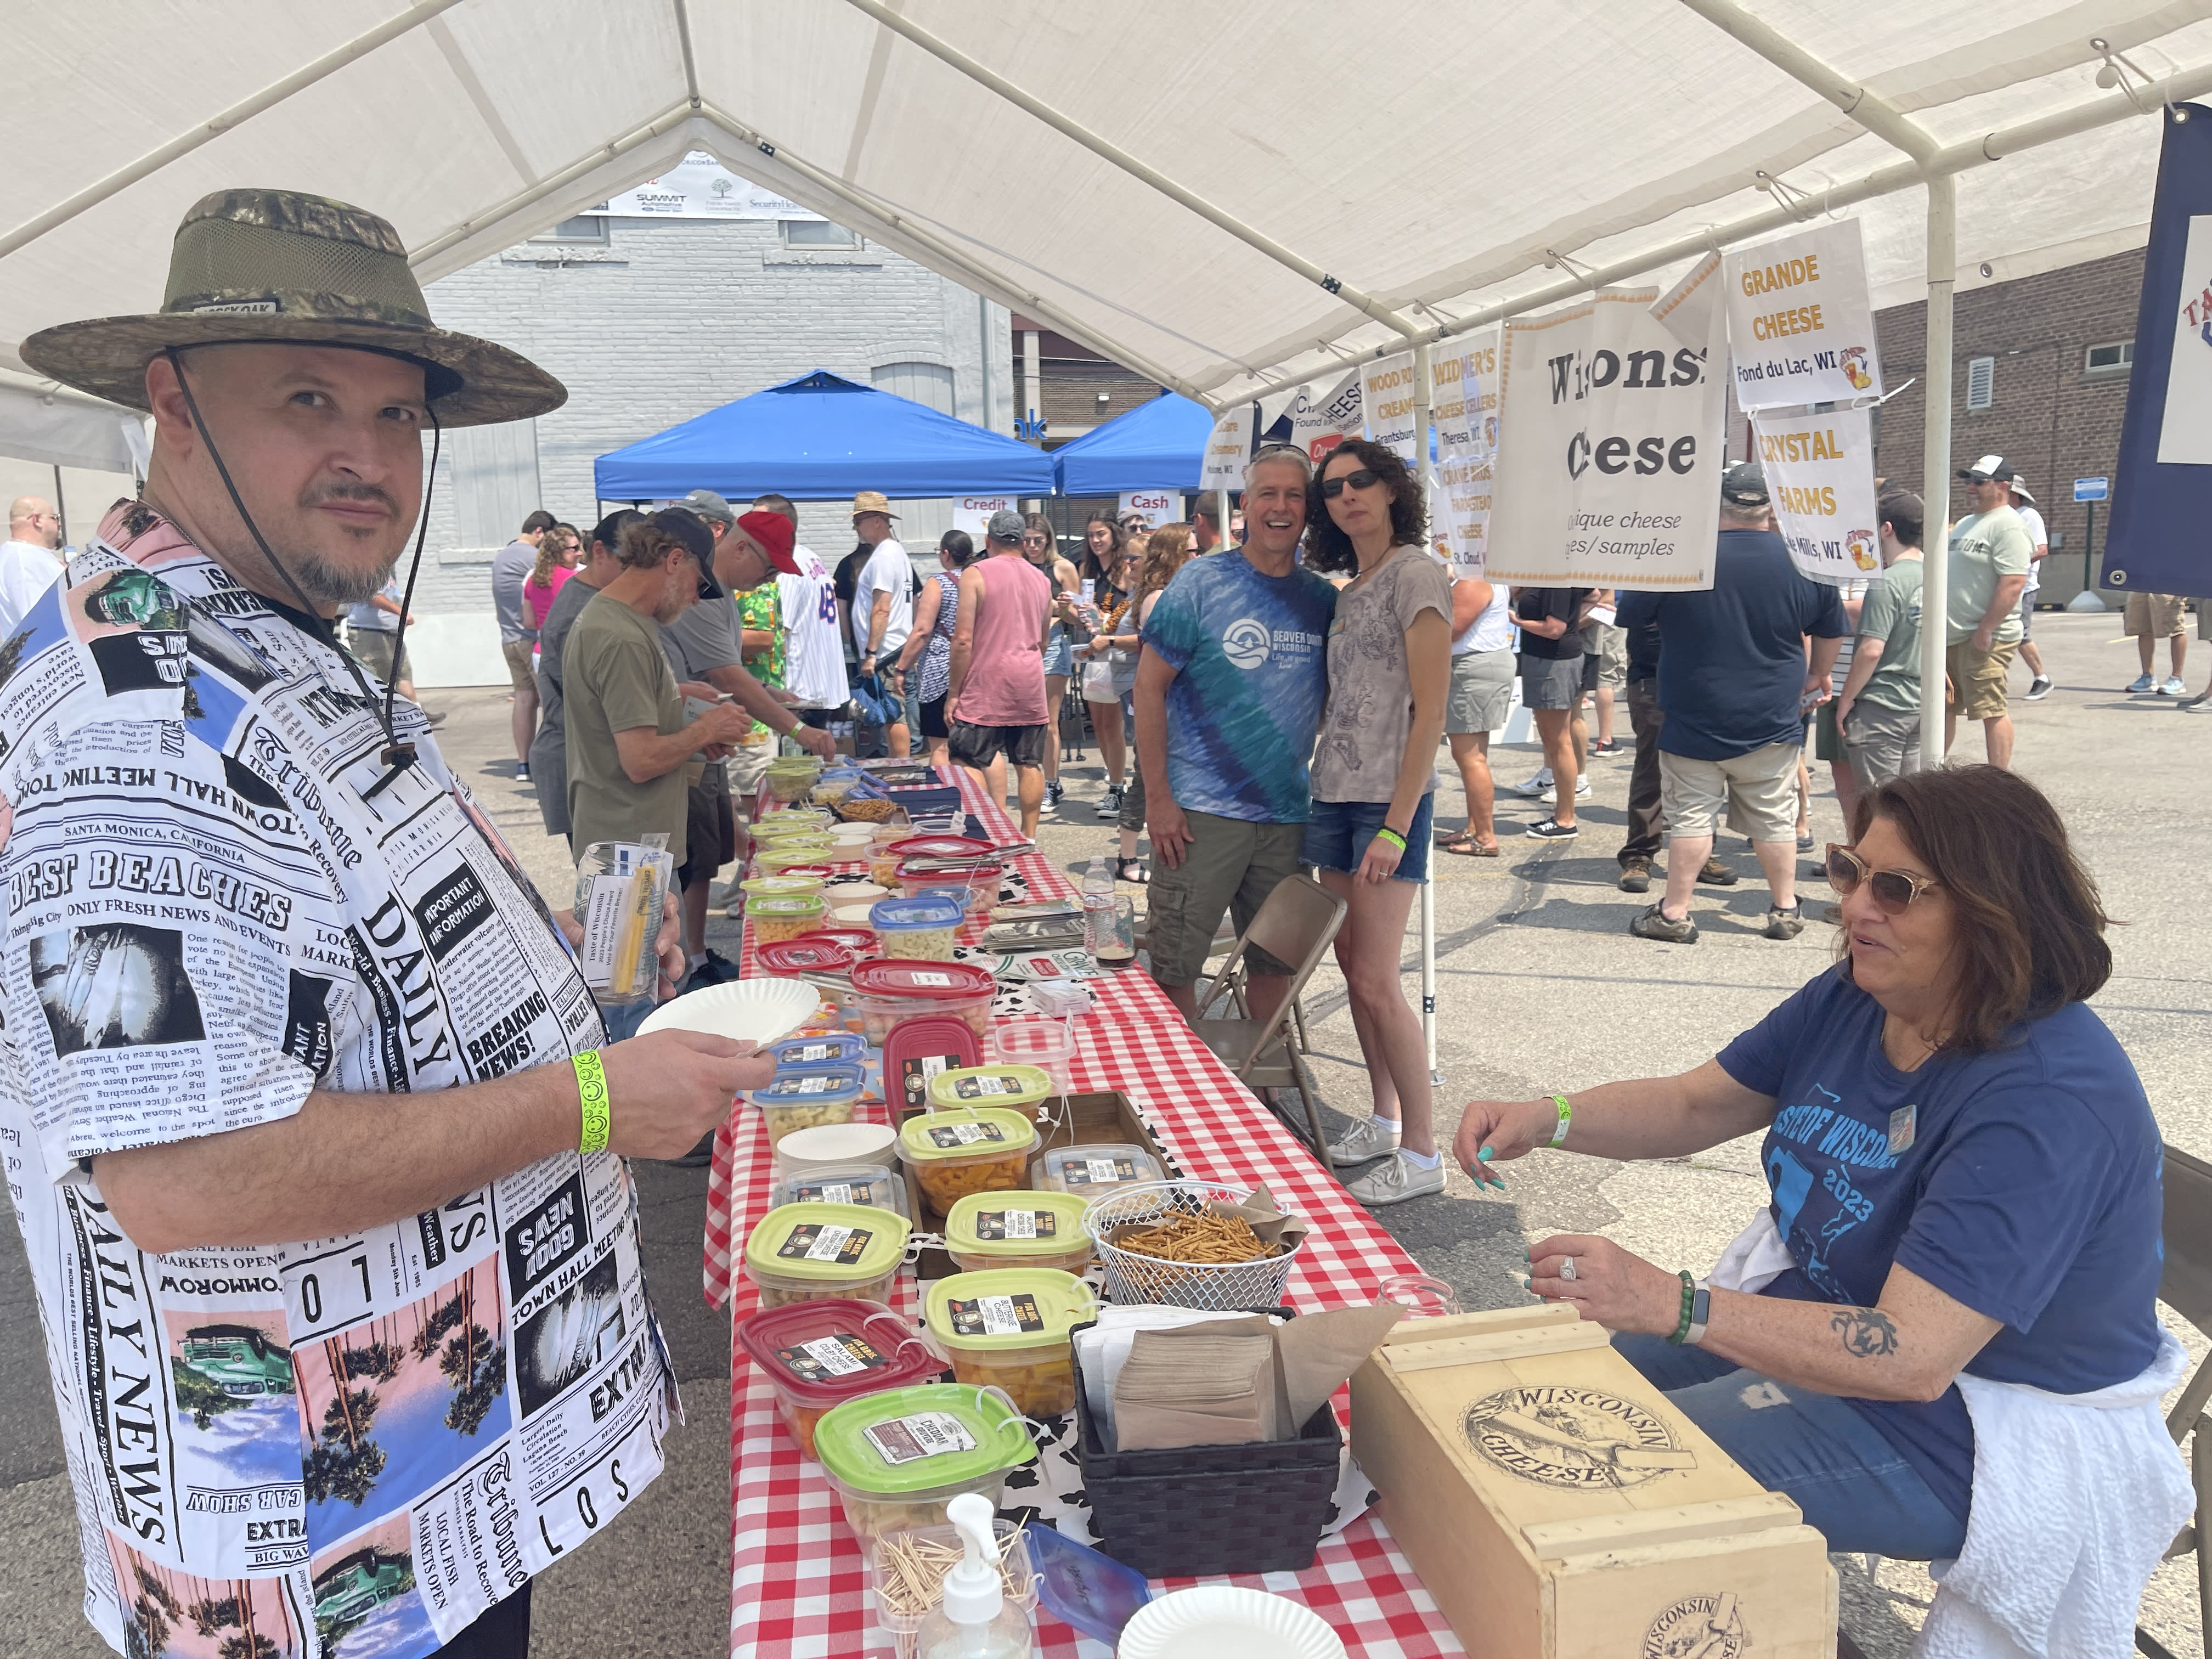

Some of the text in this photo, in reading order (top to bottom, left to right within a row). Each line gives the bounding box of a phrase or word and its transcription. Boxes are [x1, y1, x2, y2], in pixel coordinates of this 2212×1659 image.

[636, 194, 687, 202] SUMMIT
[1741, 255, 1820, 296] GRANDE
[1753, 304, 1824, 341] CHEESE
[1368, 371, 1400, 393] WOOD
[1432, 348, 1495, 386] WIDMER'S
[1737, 351, 1837, 382] Fond du Lac, WI
[1295, 417, 1322, 428] Found
[1435, 393, 1497, 420] CHEESE CELLERS
[1470, 426, 1480, 441] WI
[1759, 430, 1844, 462] CRYSTAL
[964, 498, 1007, 510] Credit
[1132, 495, 1169, 509] Cash
[1452, 495, 1492, 512] FARMSTEAD
[1777, 486, 1837, 516] FARMS
[1457, 523, 1483, 539] CHEESE
[1620, 511, 1681, 528] cheese
[1464, 552, 1481, 568] Cloud,
[1599, 538, 1674, 559] samples
[1796, 537, 1843, 562] Mills, WI
[1273, 630, 1305, 644] BEAVER
[1273, 642, 1311, 653] WISCONSIN
[16, 670, 86, 731] New entrance
[26, 661, 81, 706] discovered
[163, 770, 297, 836] TOWN HALL
[65, 825, 167, 840] SANTA MONICA,
[249, 754, 348, 905] The Recovery
[8, 850, 292, 932] BEST BEACHES
[46, 912, 62, 924] City
[67, 900, 291, 956] ONLY FRESH NEWS AND EVENTS
[429, 890, 485, 946] INFORMATION
[589, 893, 605, 962] Taste of Wisconsin
[188, 934, 207, 943] One
[438, 923, 495, 975] Underwater volcano
[188, 967, 236, 981] with large
[362, 890, 452, 1075] DAILY
[347, 932, 400, 1073] World Business Finance
[466, 990, 548, 1066] BREAKING
[214, 1041, 247, 1050] reason
[217, 1048, 258, 1061] Some of
[476, 1030, 537, 1083] NEWS!
[224, 1108, 249, 1116] since
[1797, 1106, 1835, 1144] OF
[100, 1128, 151, 1137] welcome
[1823, 1169, 1875, 1222] 2023
[71, 1207, 87, 1260] Business
[424, 1210, 438, 1262] Weather
[157, 1254, 278, 1269] MARKETS OPEN
[512, 1215, 625, 1325] TOWN HALL MEETING
[83, 1268, 93, 1316] Finance
[994, 1302, 1007, 1324] CHEESE
[88, 1325, 99, 1379] Lifestyle
[819, 1344, 853, 1370] COLBY CHEESE
[831, 1342, 859, 1365] SALAMI
[93, 1388, 106, 1428] Travel
[1518, 1389, 1668, 1449] WISCONSIN
[521, 1412, 563, 1446] Largest Daily
[526, 1423, 562, 1452] Circulation
[920, 1420, 949, 1446] CHEDDAR
[112, 1365, 166, 1546] NEWS
[522, 1429, 568, 1464] Laguna Beach
[1482, 1433, 1606, 1483] CHEESE
[529, 1449, 585, 1492] VOL. 127 NO. 39
[187, 1489, 302, 1514] CAR SHOW
[539, 1459, 629, 1556] LOS
[462, 1479, 483, 1560] The Road to
[477, 1452, 533, 1588] Tribune
[255, 1551, 279, 1564] BIG
[436, 1510, 460, 1587] LOCAL FISH
[457, 1525, 468, 1559] ANALYSIS
[418, 1510, 448, 1610] MARKETS OPEN
[1647, 1599, 1715, 1659] WISCONSIN
